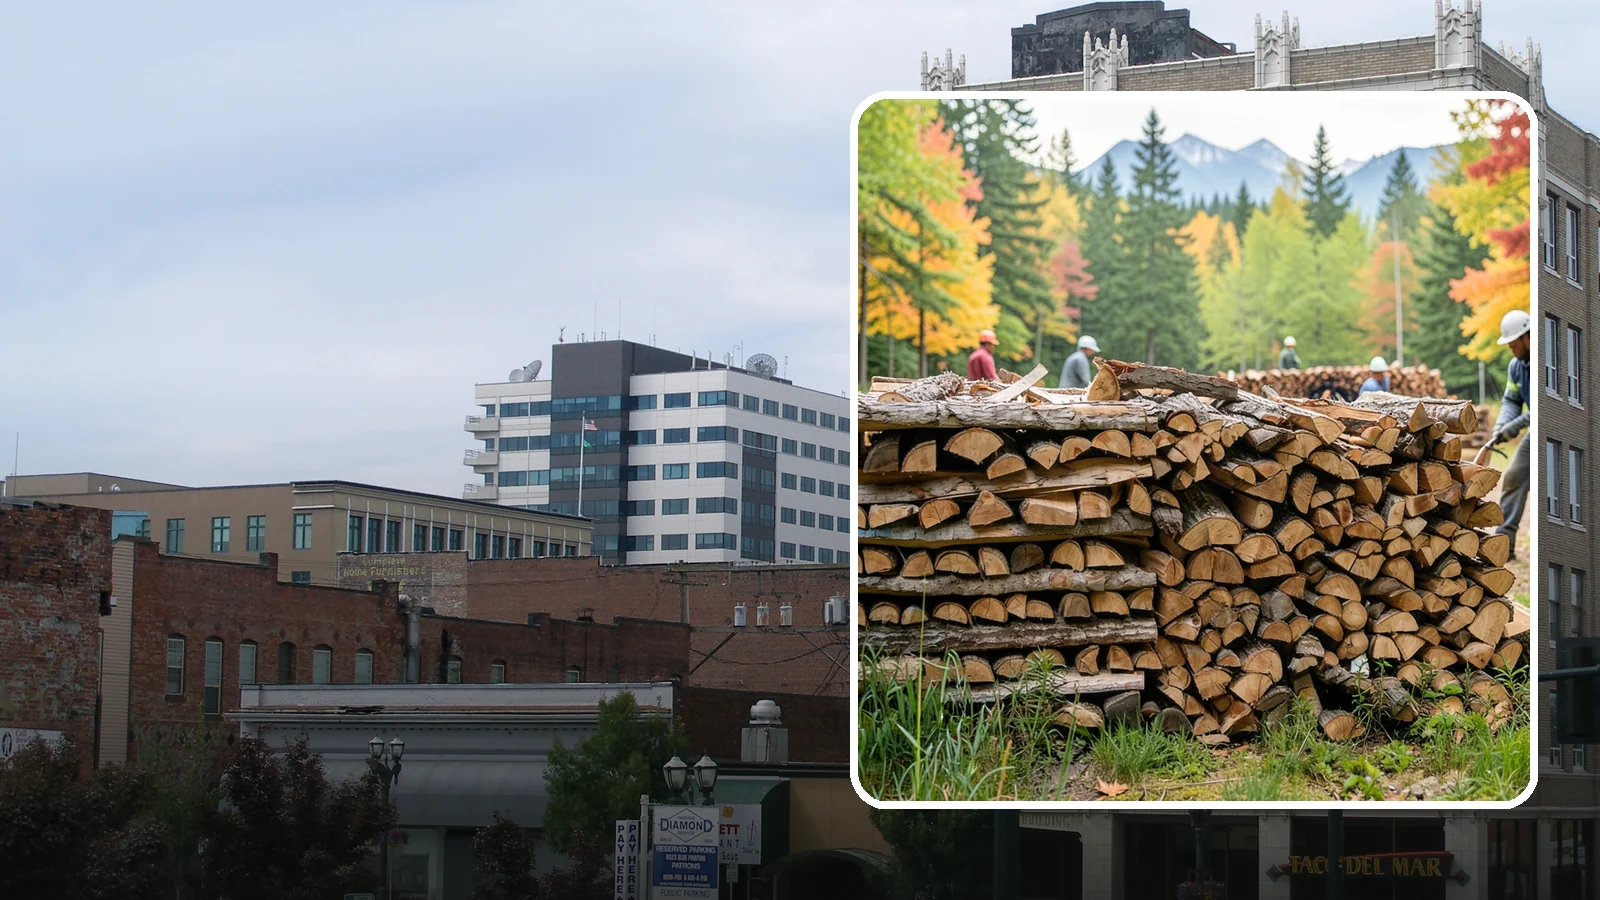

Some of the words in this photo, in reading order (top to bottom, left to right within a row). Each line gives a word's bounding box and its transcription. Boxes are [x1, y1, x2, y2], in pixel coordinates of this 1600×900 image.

[370, 566, 427, 577] Furnishers
[660, 818, 713, 833] DIAMOND
[1022, 815, 1069, 828] BUILDING
[617, 825, 625, 853] PAY
[628, 824, 637, 853] PAY
[656, 845, 688, 854] RESERVED
[689, 846, 716, 855] PARKING
[721, 851, 739, 861] Soup
[671, 862, 701, 870] PATRONS
[1346, 856, 1384, 876] DEL
[1393, 857, 1442, 877] MAR
[616, 856, 625, 894] HERE
[627, 856, 636, 893] HERE
[660, 888, 682, 897] PUBLIC
[683, 889, 710, 898] PARKING
